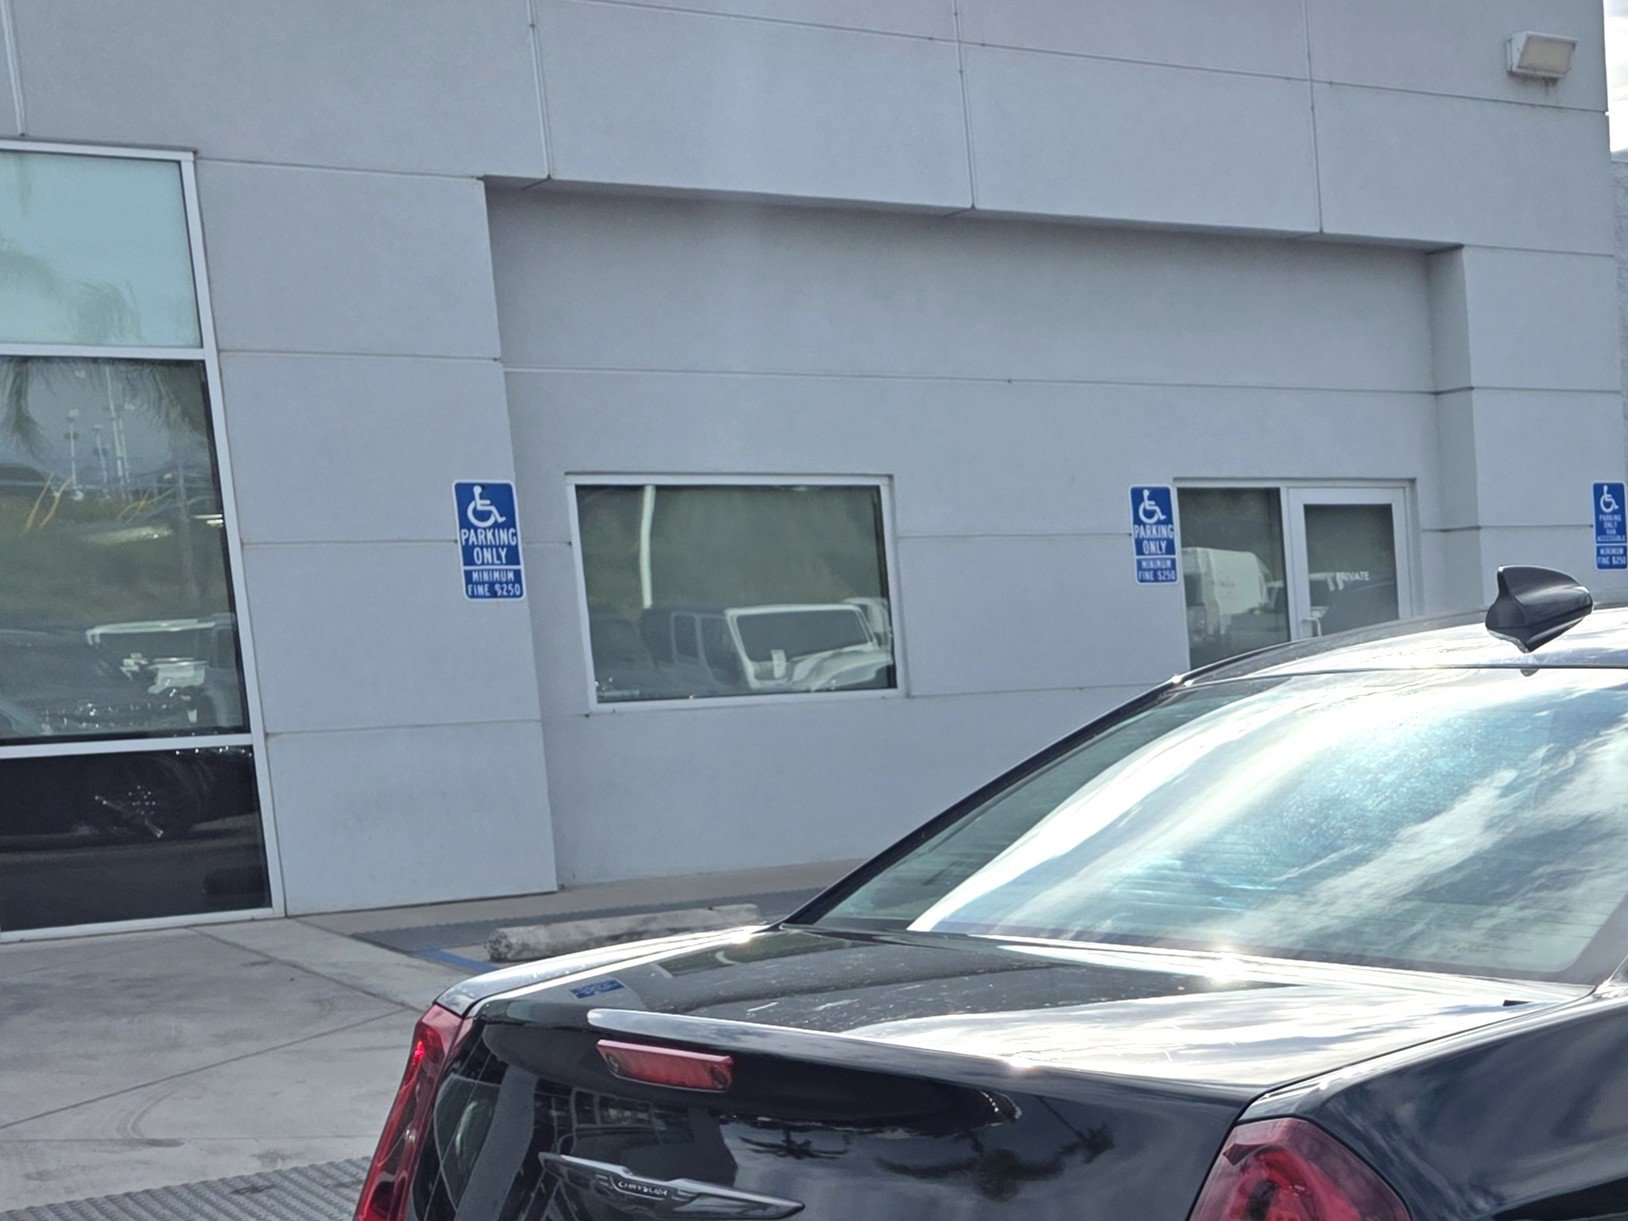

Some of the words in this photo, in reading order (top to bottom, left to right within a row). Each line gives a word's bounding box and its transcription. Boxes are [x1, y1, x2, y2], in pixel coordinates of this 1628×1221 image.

[461, 528, 517, 546] PARKING
[1134, 524, 1174, 538] PARKING
[1142, 540, 1167, 554] ONLY
[473, 547, 507, 564] ONLY
[472, 571, 514, 582] MINIMUM
[467, 584, 490, 596] FINE
[494, 583, 521, 596] $250
